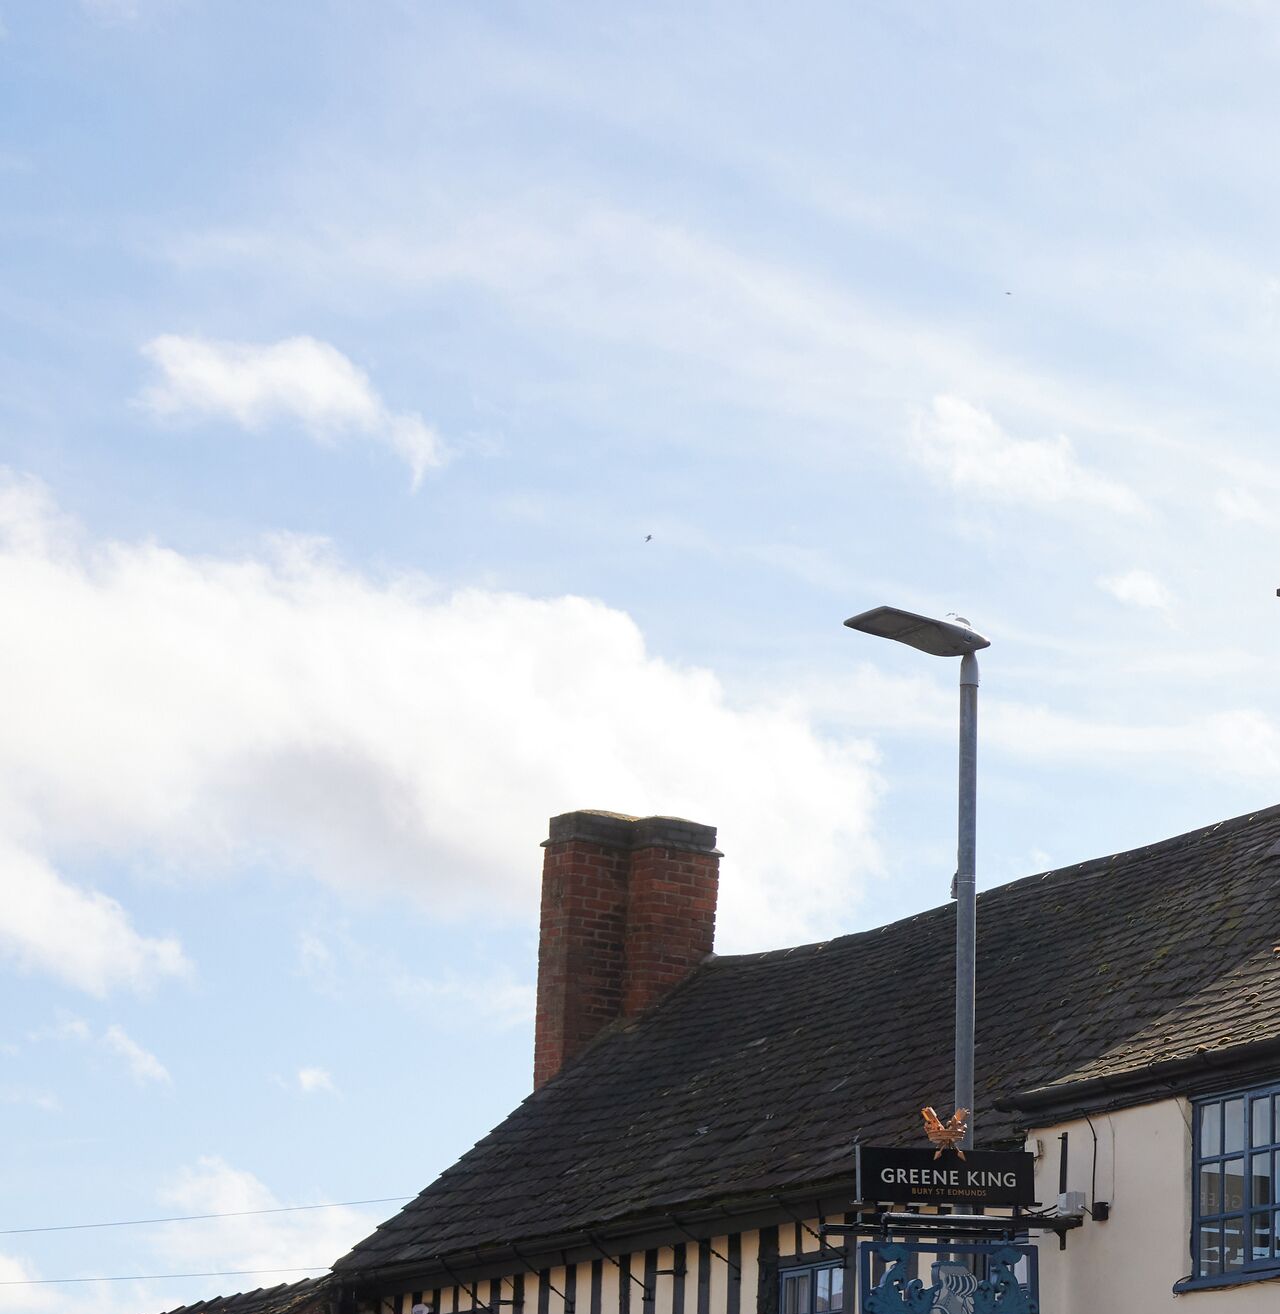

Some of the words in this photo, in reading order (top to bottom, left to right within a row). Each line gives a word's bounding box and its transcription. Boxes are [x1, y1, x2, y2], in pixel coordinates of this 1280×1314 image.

[881, 1168, 959, 1186] GREENE
[967, 1171, 1017, 1187] KING
[911, 1187, 933, 1195] BURY
[947, 1188, 987, 1197] EDMUNDS
